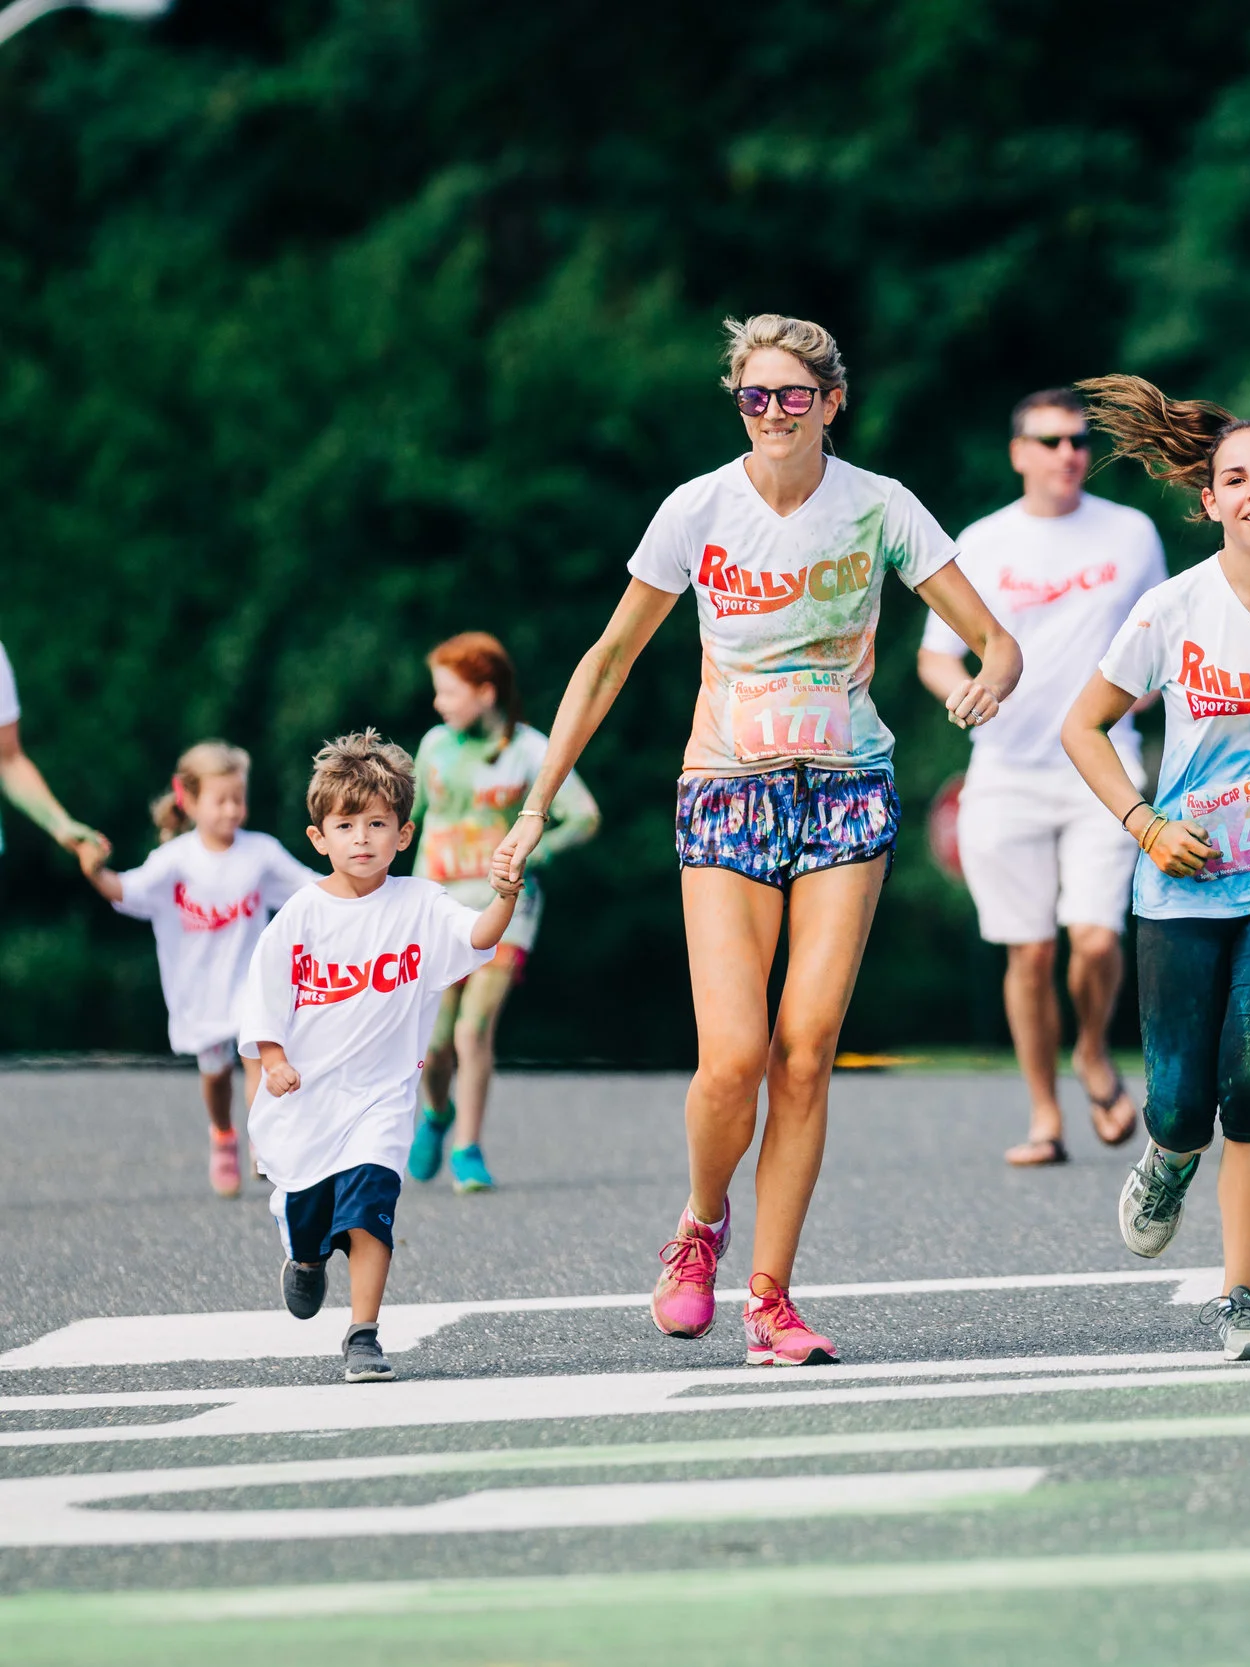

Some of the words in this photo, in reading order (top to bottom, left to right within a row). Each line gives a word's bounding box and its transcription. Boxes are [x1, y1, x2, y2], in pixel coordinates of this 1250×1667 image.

[698, 543, 872, 603] RALLYCAP
[714, 593, 761, 614] Sports
[1192, 695, 1238, 716] Sports
[754, 705, 831, 745] 177
[1186, 787, 1240, 814] RALLYCAP
